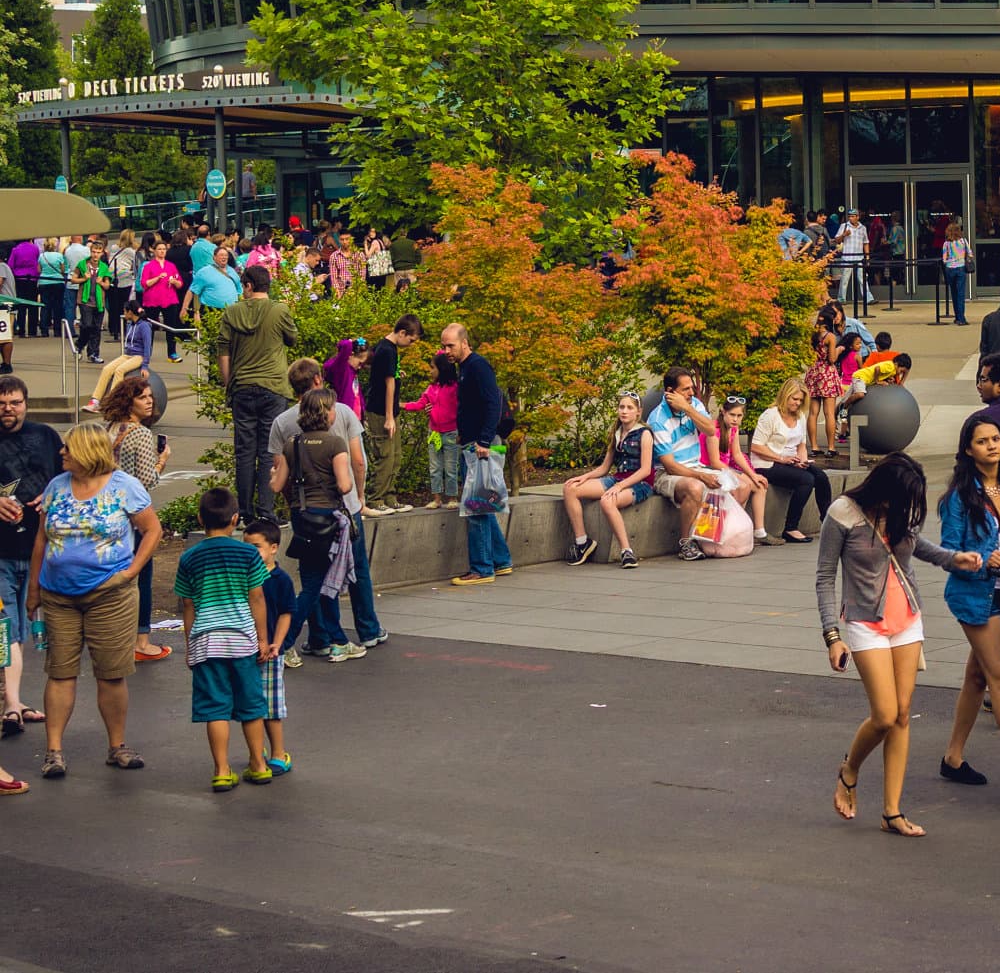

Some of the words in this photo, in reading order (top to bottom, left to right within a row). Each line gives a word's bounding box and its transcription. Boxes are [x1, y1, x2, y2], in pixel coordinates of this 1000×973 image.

[84, 79, 117, 98] DECK
[124, 73, 185, 94] TICKETS
[225, 72, 270, 87] VIEWING
